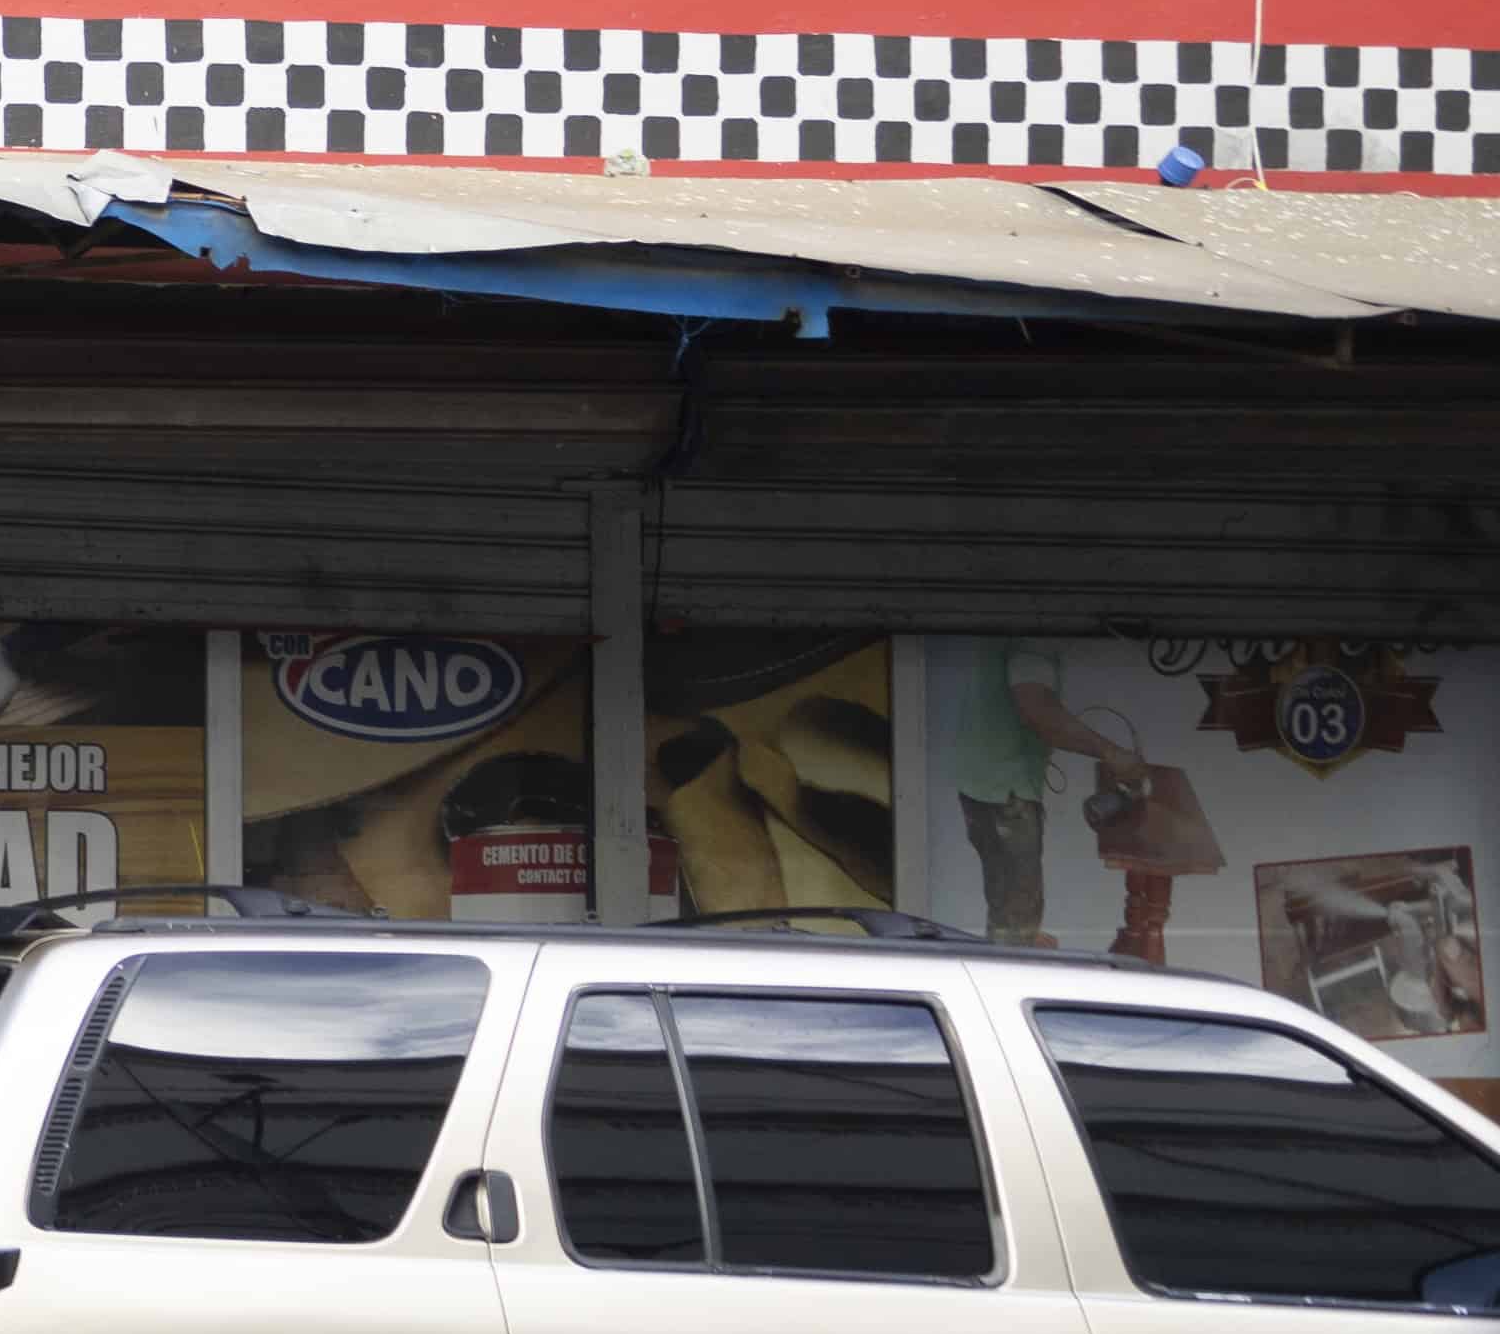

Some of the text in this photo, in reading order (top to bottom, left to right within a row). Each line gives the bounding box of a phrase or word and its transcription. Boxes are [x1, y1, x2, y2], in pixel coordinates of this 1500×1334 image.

[307, 647, 493, 712] CANO
[1291, 702, 1347, 745] 03
[482, 843, 550, 867] CEMENTO
[553, 844, 575, 864] DE
[517, 868, 572, 885] CONTACT
